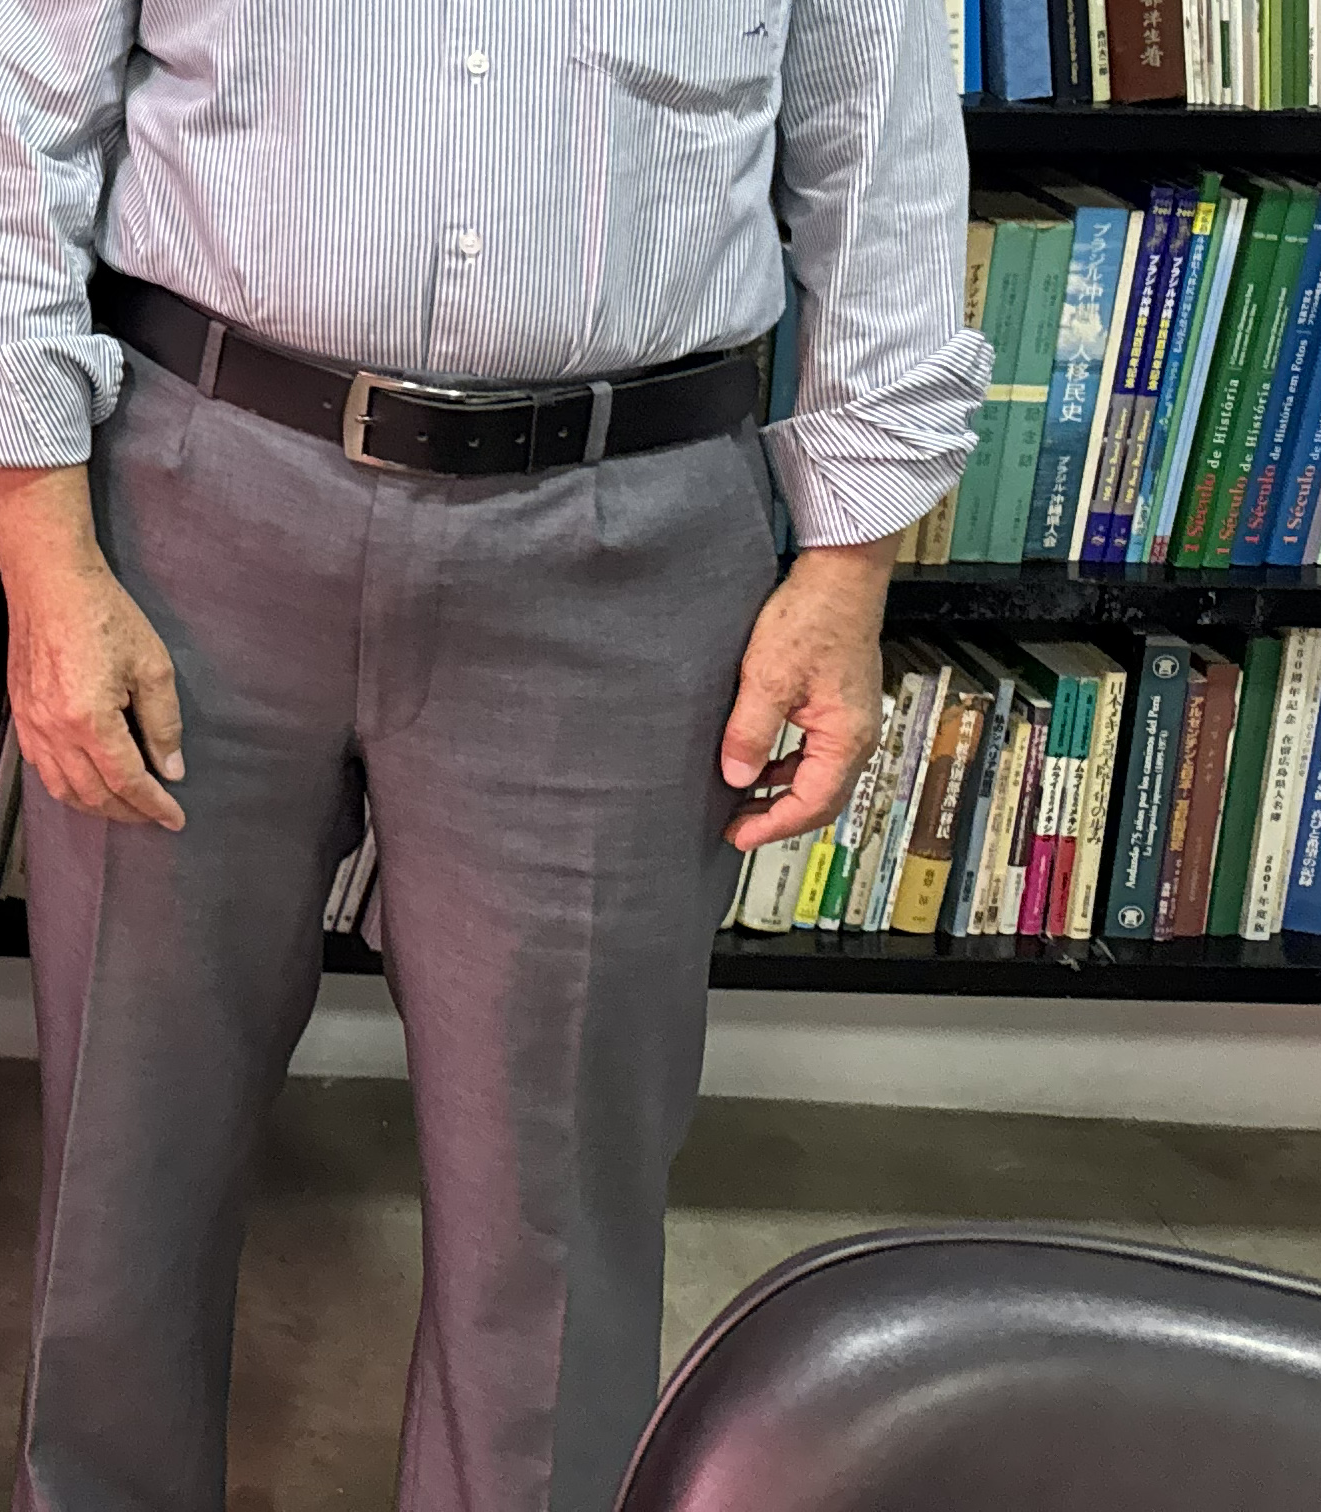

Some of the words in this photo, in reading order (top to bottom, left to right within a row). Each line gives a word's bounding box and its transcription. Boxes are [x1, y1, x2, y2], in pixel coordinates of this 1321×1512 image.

[1291, 338, 1309, 367] Fotos
[1288, 369, 1300, 387] em
[1212, 378, 1241, 445] História
[1244, 381, 1271, 447] História
[1273, 389, 1295, 442] História
[1207, 447, 1222, 469] de
[1239, 450, 1252, 473] de
[1270, 443, 1281, 461] de
[1310, 442, 1321, 461] de
[1187, 473, 1216, 540] Século
[1247, 464, 1276, 532] Século
[1285, 463, 1316, 531] Século
[1218, 476, 1247, 542] Século
[1245, 535, 1260, 545] 1
[1283, 535, 1299, 546] 1
[1149, 695, 1162, 717] Perú
[1148, 719, 1157, 734] del
[1142, 735, 1156, 776] caminos
[1142, 778, 1150, 792] los
[1138, 795, 1148, 811] por
[1133, 812, 1144, 833] años
[1129, 834, 1141, 849] 75
[1124, 850, 1138, 889] Andando
